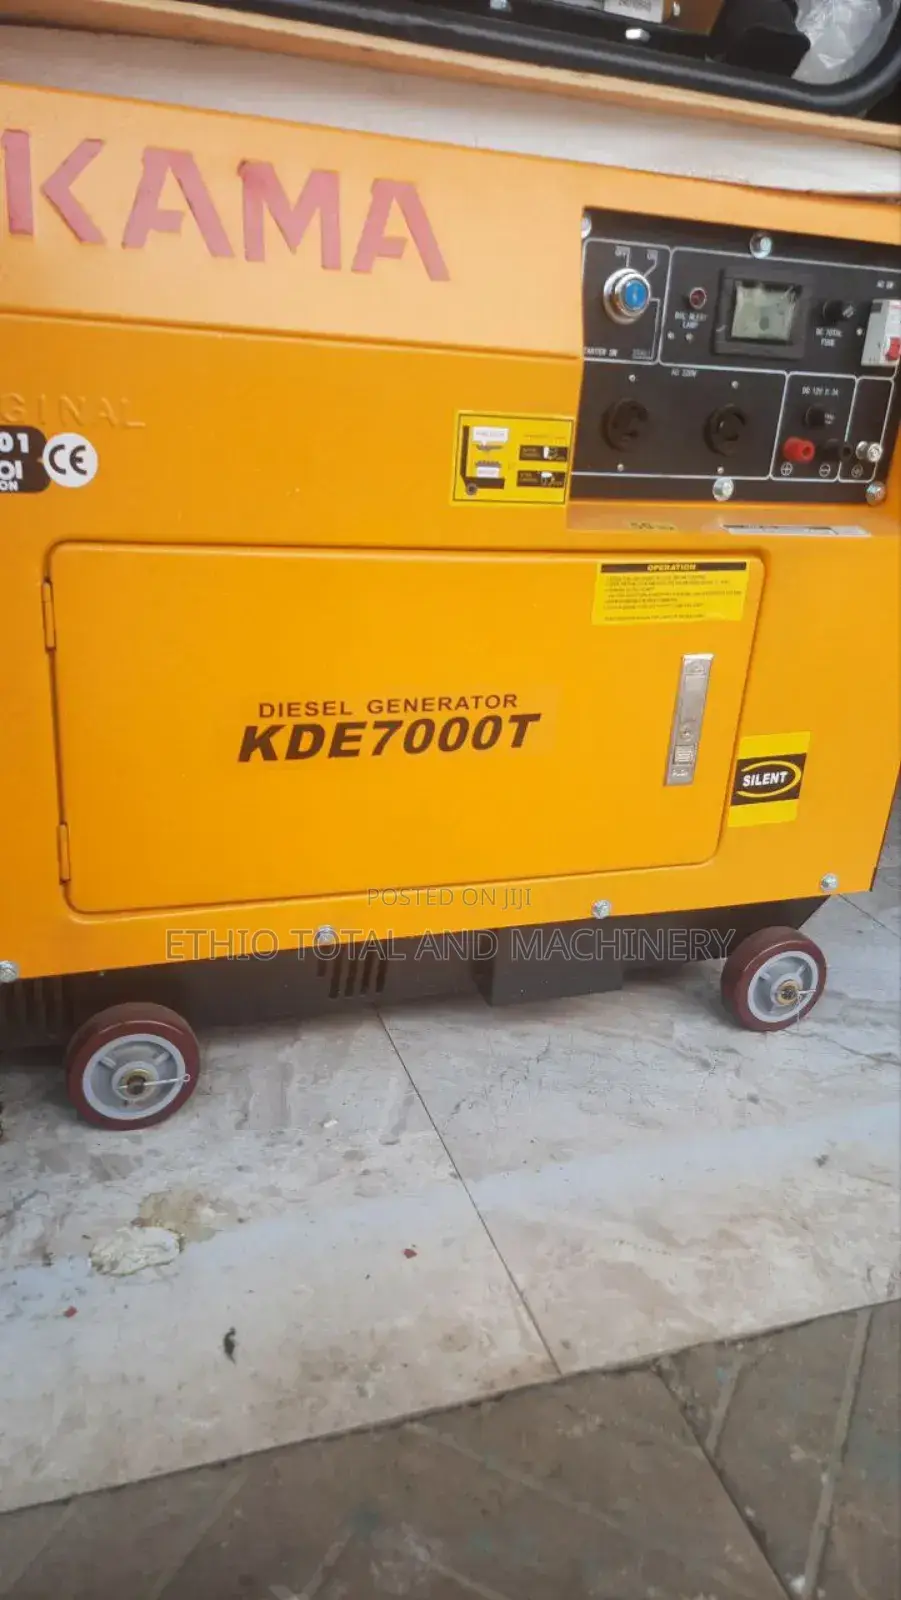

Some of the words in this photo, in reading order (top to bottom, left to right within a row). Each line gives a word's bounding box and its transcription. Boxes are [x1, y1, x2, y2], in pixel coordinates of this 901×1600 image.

[2, 129, 450, 282] KAMA
[647, 563, 697, 572] OPERATION
[258, 701, 353, 719] DIESEL
[366, 693, 518, 715] GENERATOR
[237, 712, 542, 763] KDE7000T
[742, 771, 789, 787] SILENT
